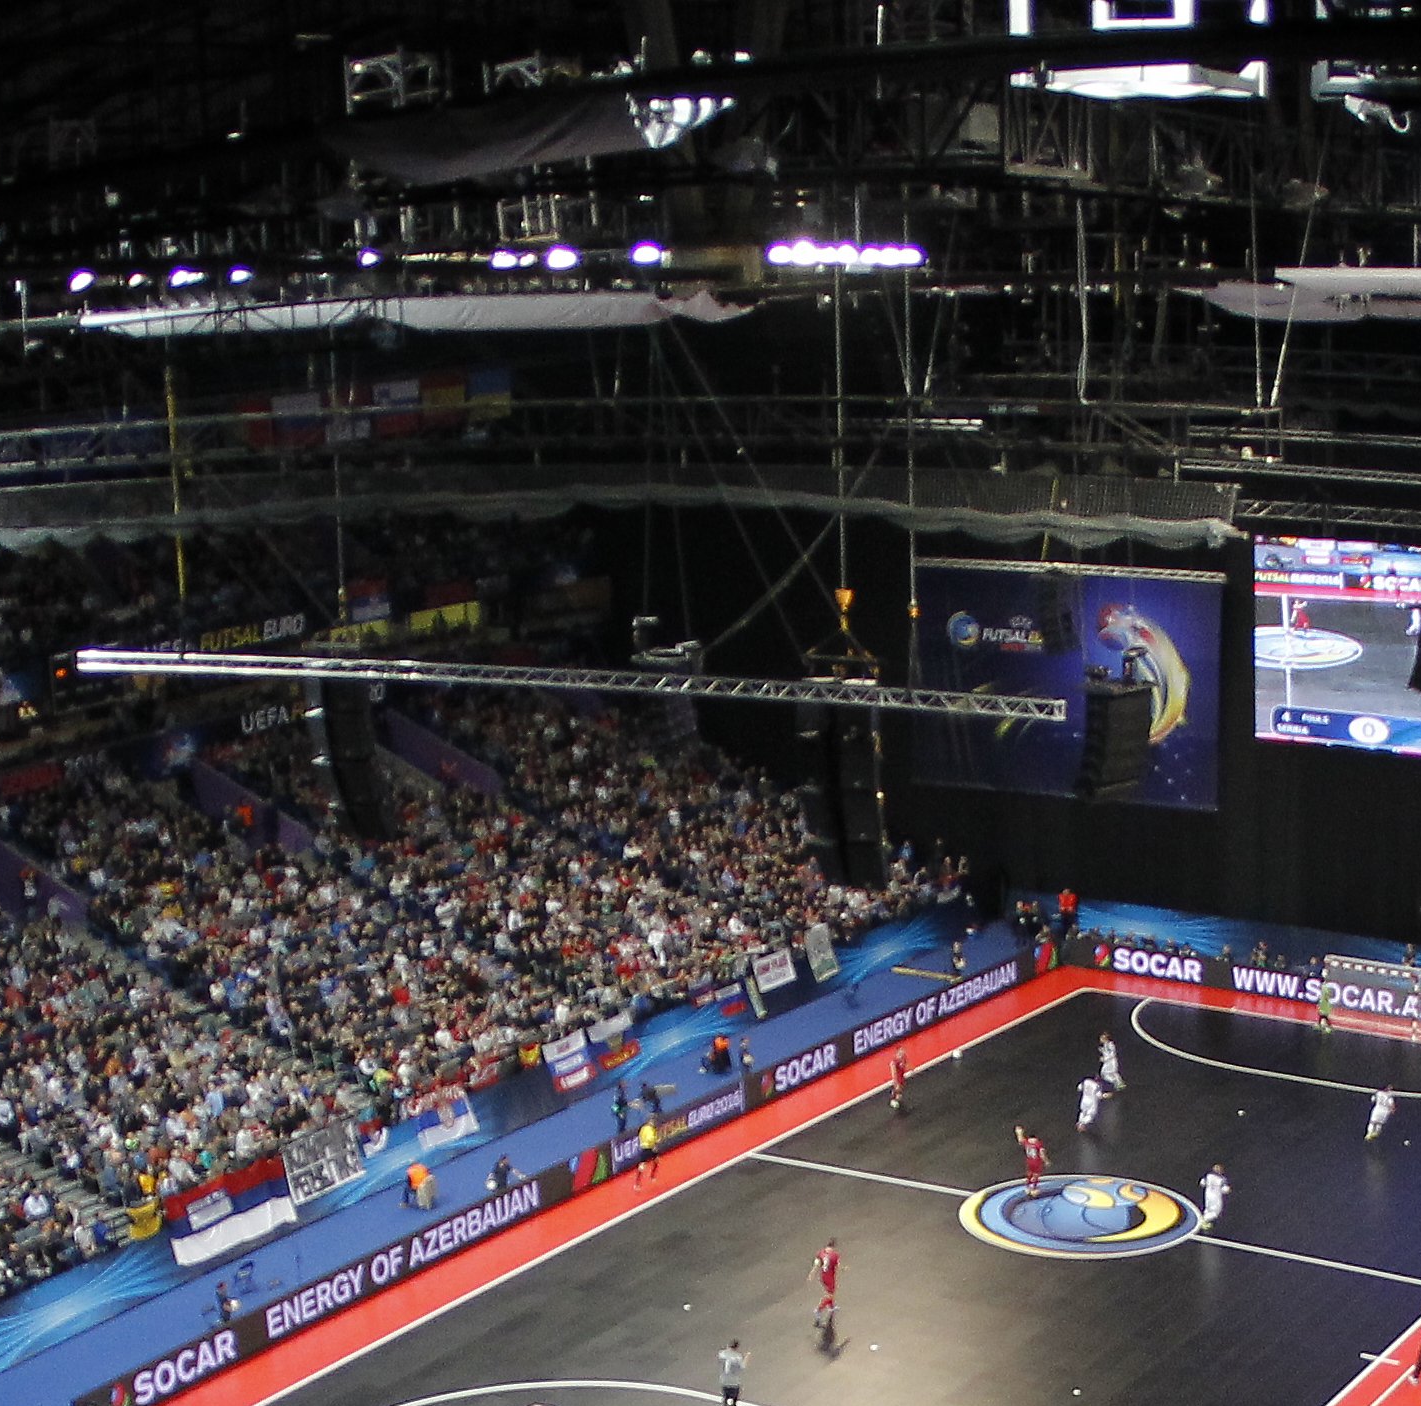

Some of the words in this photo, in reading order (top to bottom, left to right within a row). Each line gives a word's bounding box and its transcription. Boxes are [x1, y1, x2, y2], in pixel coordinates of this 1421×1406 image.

[240, 704, 290, 735] UEFA
[1112, 946, 1203, 984] SOCAR
[774, 1043, 838, 1092] SOCAR
[853, 1007, 914, 1055] ENERGY
[915, 996, 937, 1026] OF
[937, 960, 1019, 1018] AZERBAIJAN
[133, 1329, 238, 1406] SOCAR
[264, 1264, 368, 1340] ENERGY
[369, 1244, 404, 1285] OF
[408, 1180, 541, 1270] AZERBAIJAN
